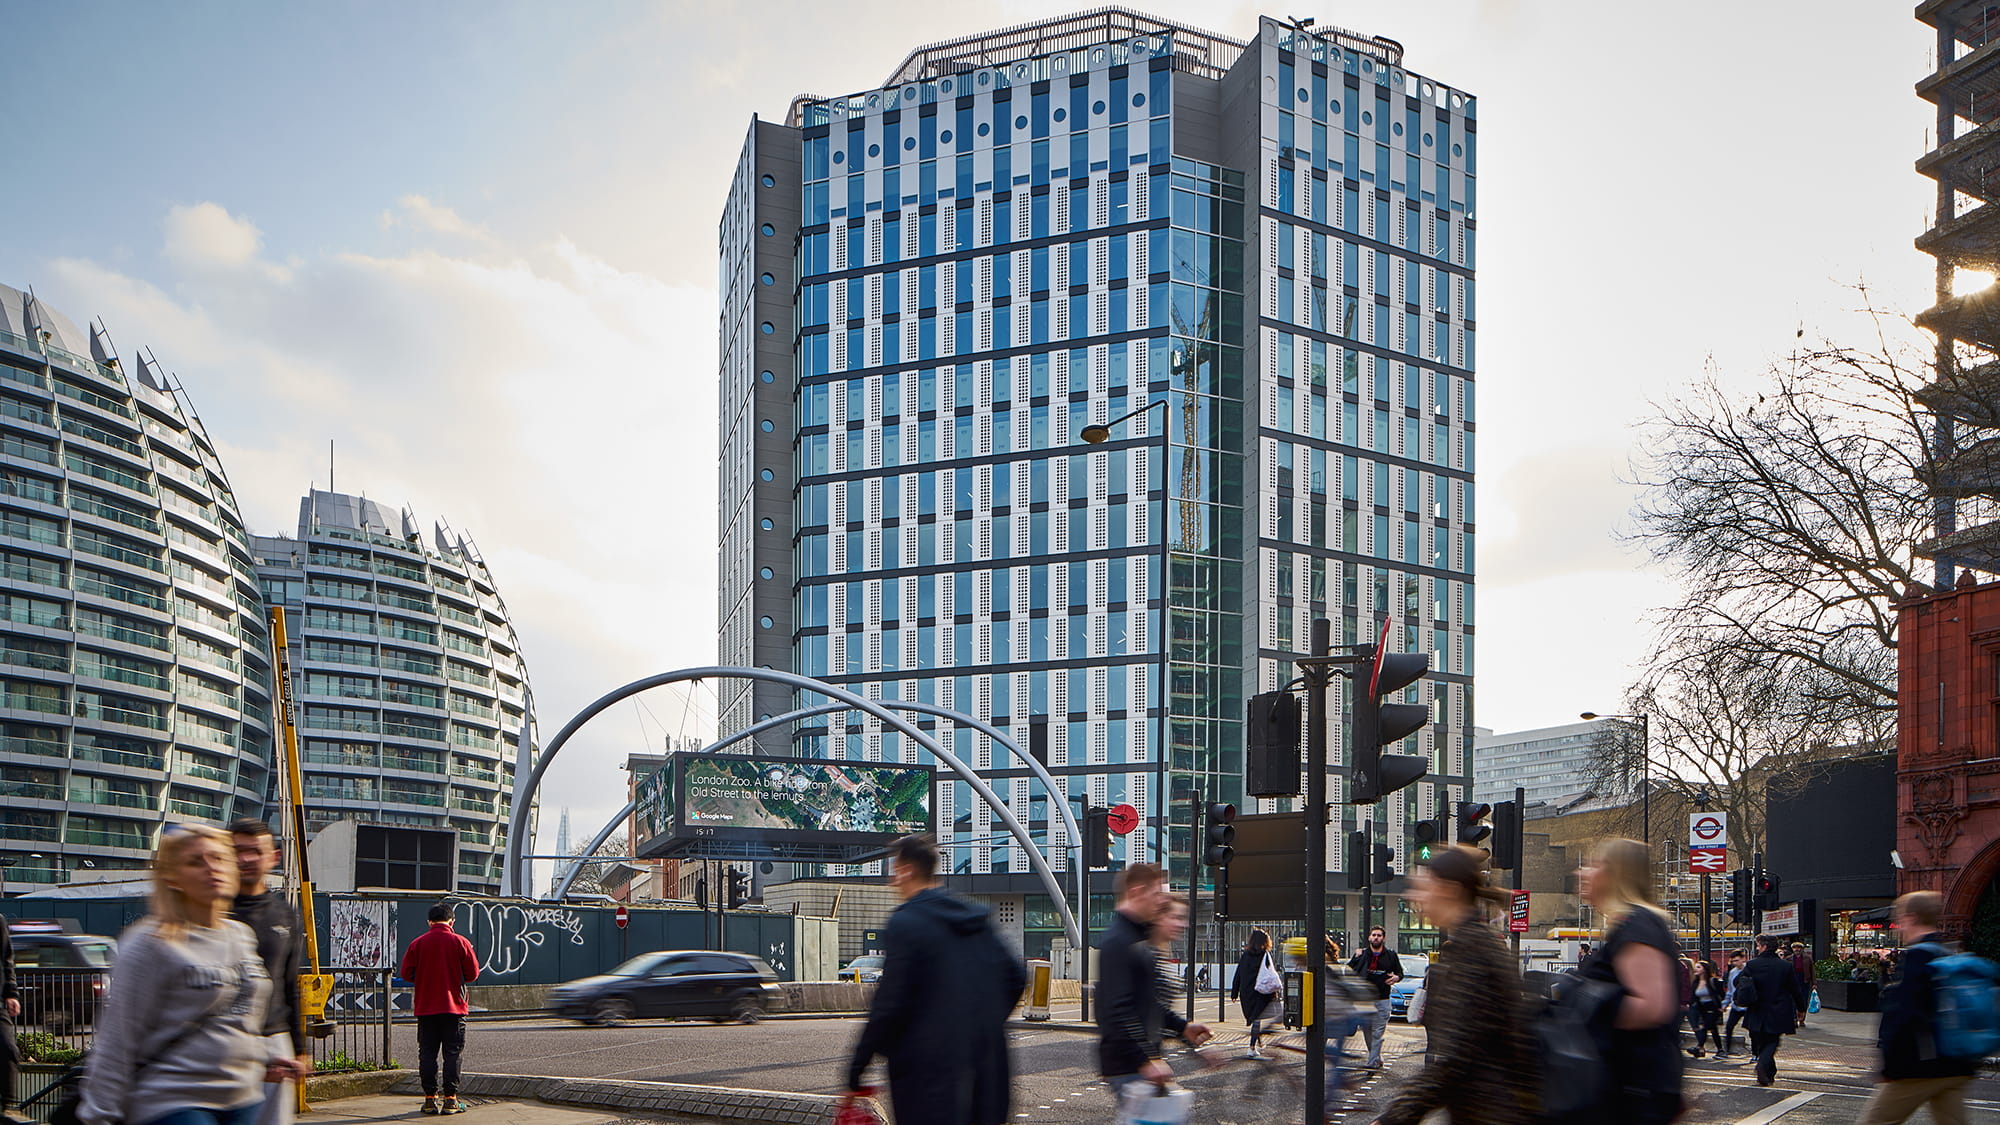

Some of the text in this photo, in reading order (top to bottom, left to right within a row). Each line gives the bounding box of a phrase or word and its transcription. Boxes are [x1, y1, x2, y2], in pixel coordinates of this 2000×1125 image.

[691, 775, 728, 786] London
[731, 776, 753, 787] Zoo.
[754, 777, 762, 787] A
[764, 777, 783, 788] bike
[805, 779, 828, 790] rom
[691, 787, 708, 798] Old
[710, 788, 740, 799] Street
[741, 790, 752, 799] to
[754, 789, 769, 800] the
[700, 812, 719, 820] Google
[1512, 903, 1529, 911] SHIFT
